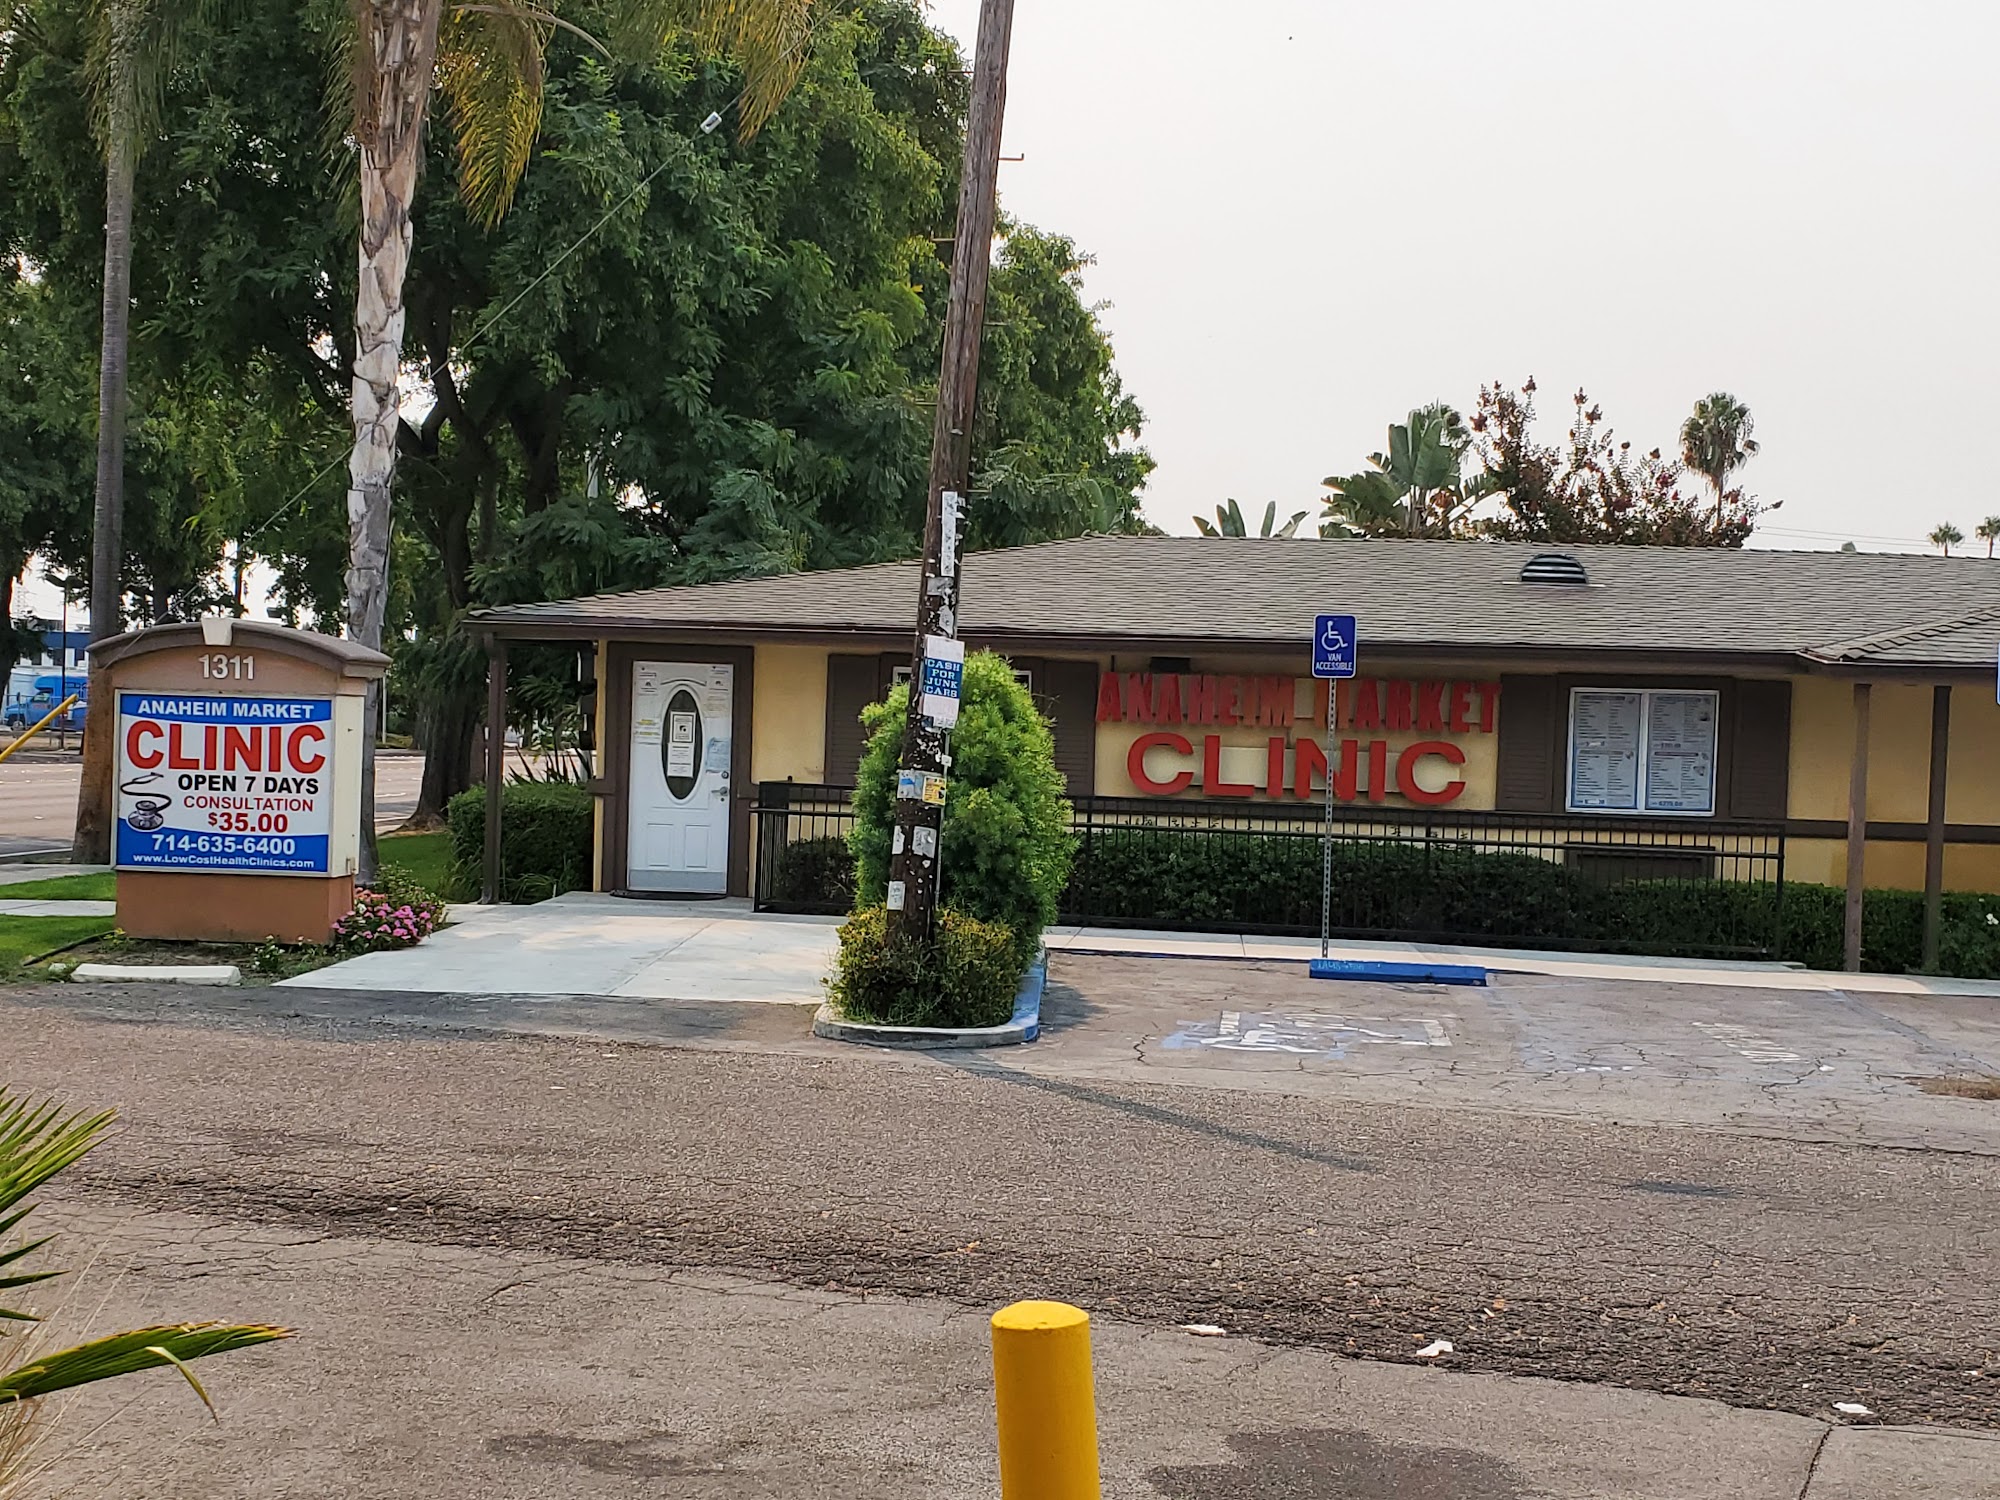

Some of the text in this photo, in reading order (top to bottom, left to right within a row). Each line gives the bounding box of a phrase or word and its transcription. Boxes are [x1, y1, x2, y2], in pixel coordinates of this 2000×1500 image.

[927, 659, 960, 672] CASH
[1327, 653, 1342, 661] VAN
[198, 654, 255, 680] 1311
[931, 668, 955, 680] FOR
[1315, 662, 1353, 671] ACCESSIBLE
[926, 686, 957, 698] CARS
[927, 677, 958, 689] JUNK
[138, 700, 315, 719] ANAHEIM MARKET
[1096, 672, 1502, 733] ANAHEIM MARKET
[126, 720, 326, 774] CLINIC
[1127, 732, 1466, 805] CLINIC
[178, 774, 319, 795] OPEN 7 DAYS
[184, 795, 313, 812] CONSULTATION
[208, 812, 288, 833] $35.00
[152, 834, 296, 855] 714-635-6400
[133, 854, 314, 868] www.LowCostHealthClinics.com
